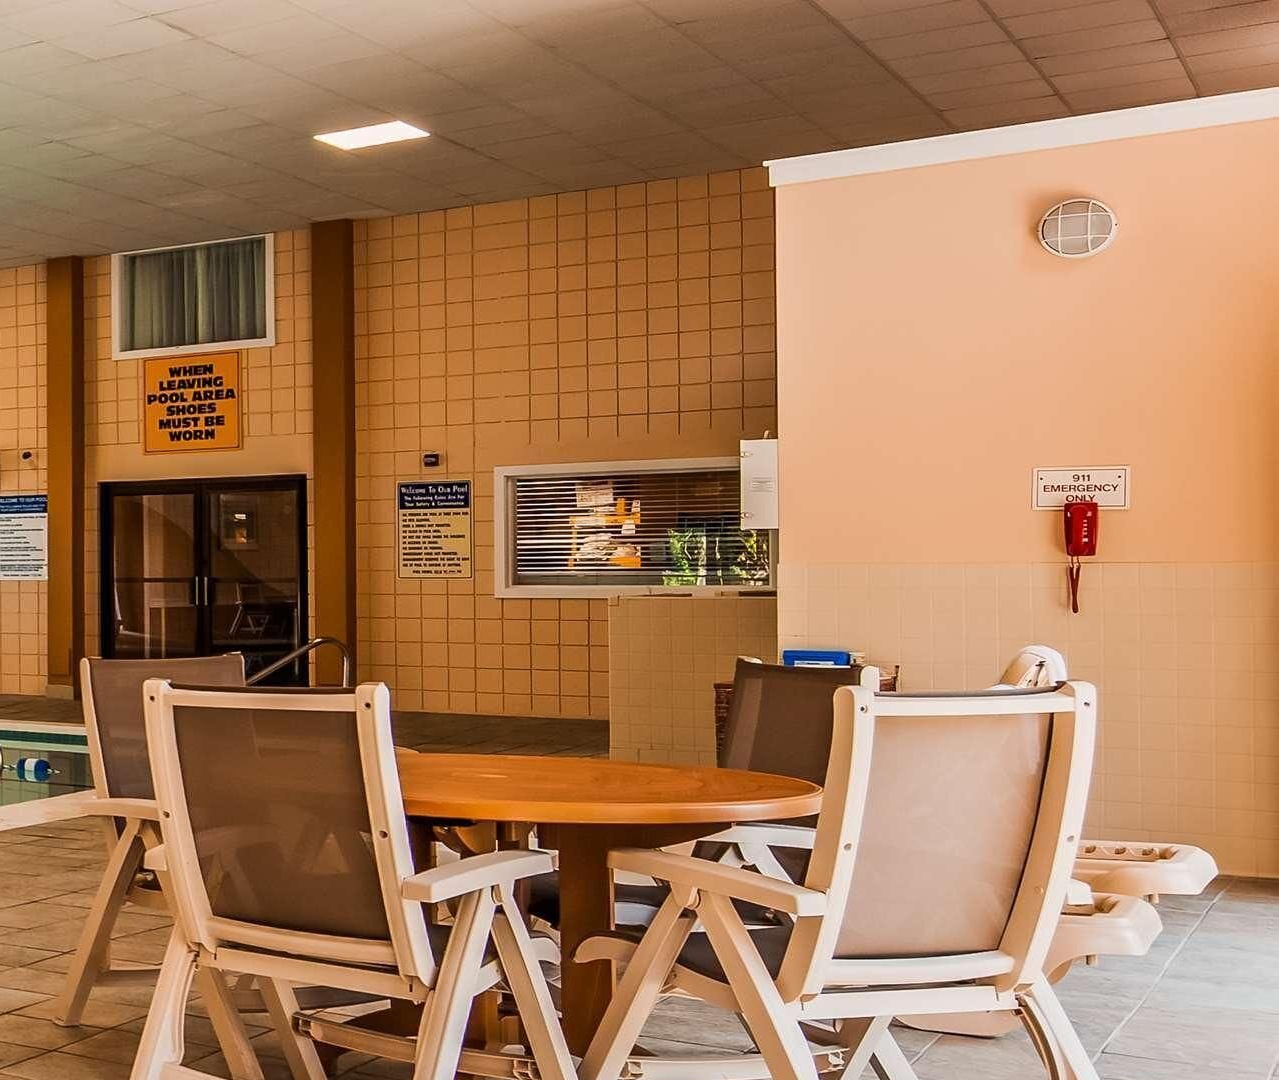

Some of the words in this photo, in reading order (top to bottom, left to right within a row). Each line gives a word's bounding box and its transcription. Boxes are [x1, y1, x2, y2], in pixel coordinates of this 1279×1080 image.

[168, 364, 214, 378] WHEN
[159, 376, 223, 391] LEAVING
[147, 391, 188, 405] POOL
[192, 388, 236, 401] AREA
[166, 402, 217, 416] SHOES
[158, 416, 201, 430] MUST
[204, 415, 225, 427] BE
[168, 428, 216, 442] WORN
[1072, 474, 1091, 482] 911
[1043, 484, 1119, 493] EMERGENCY
[1065, 494, 1096, 503] ONLY
